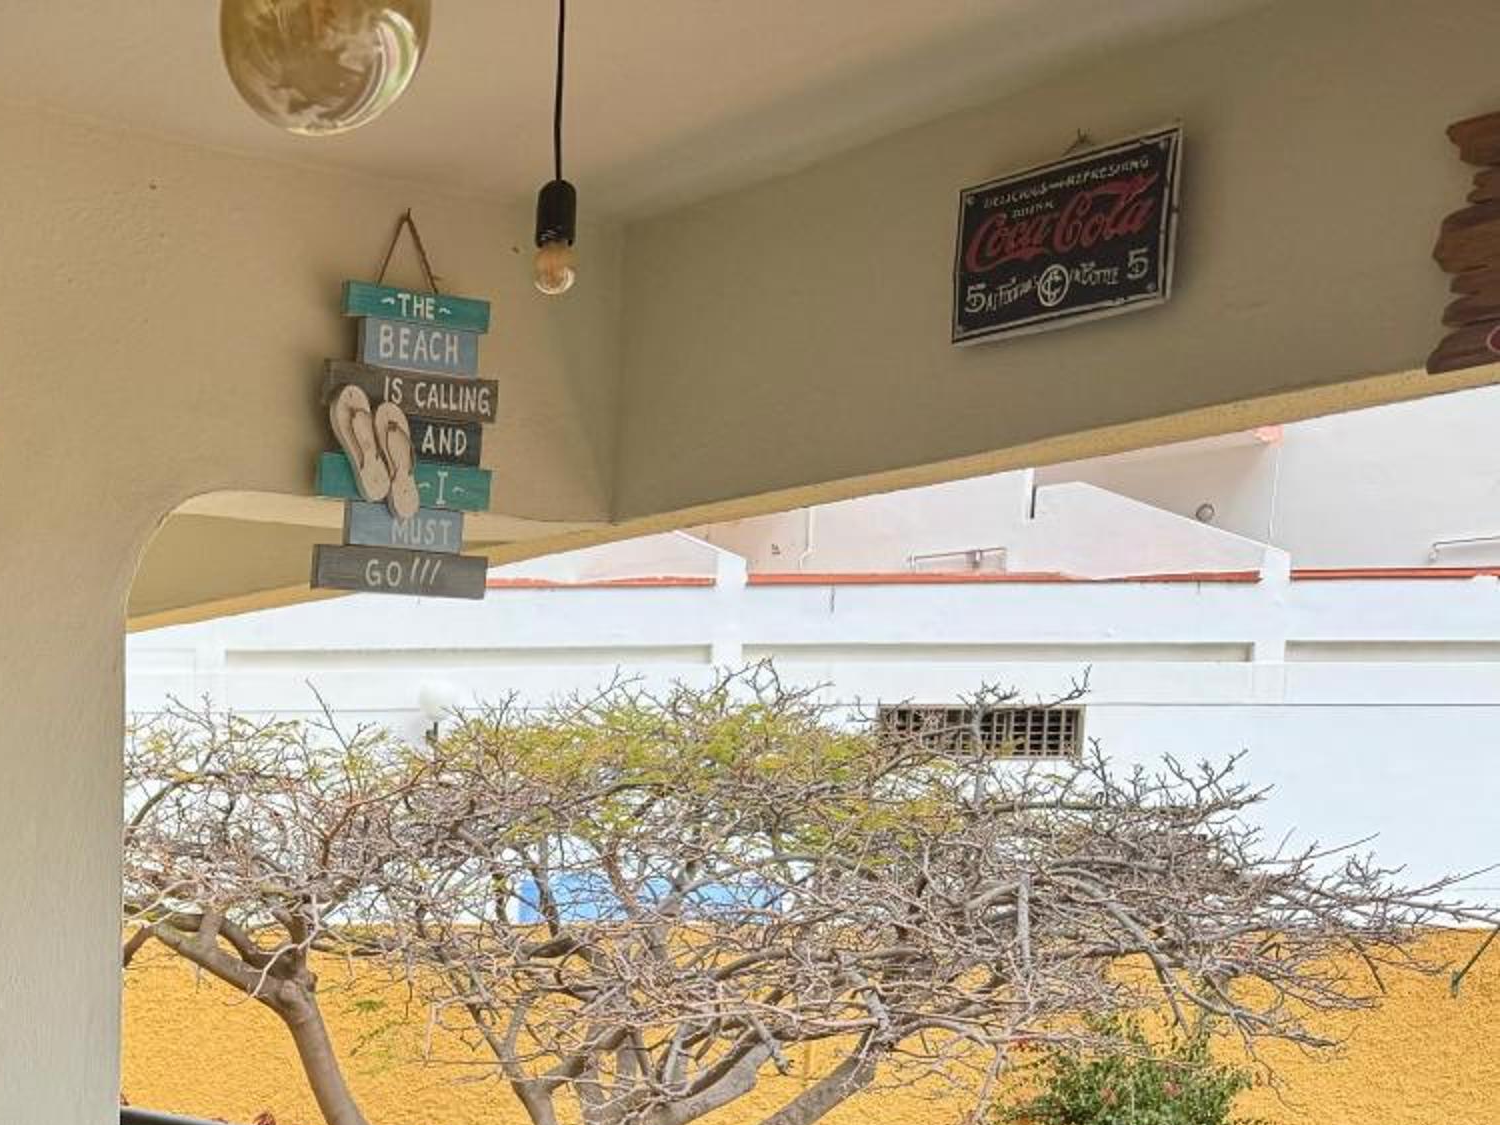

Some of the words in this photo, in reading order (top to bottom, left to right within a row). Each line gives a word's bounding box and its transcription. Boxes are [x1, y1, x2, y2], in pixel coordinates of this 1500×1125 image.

[379, 325, 459, 365] BEACH
[384, 376, 403, 404] IS
[415, 383, 491, 416] CALLING
[422, 425, 467, 456] AND
[437, 471, 448, 505] I
[391, 519, 452, 545] MUST
